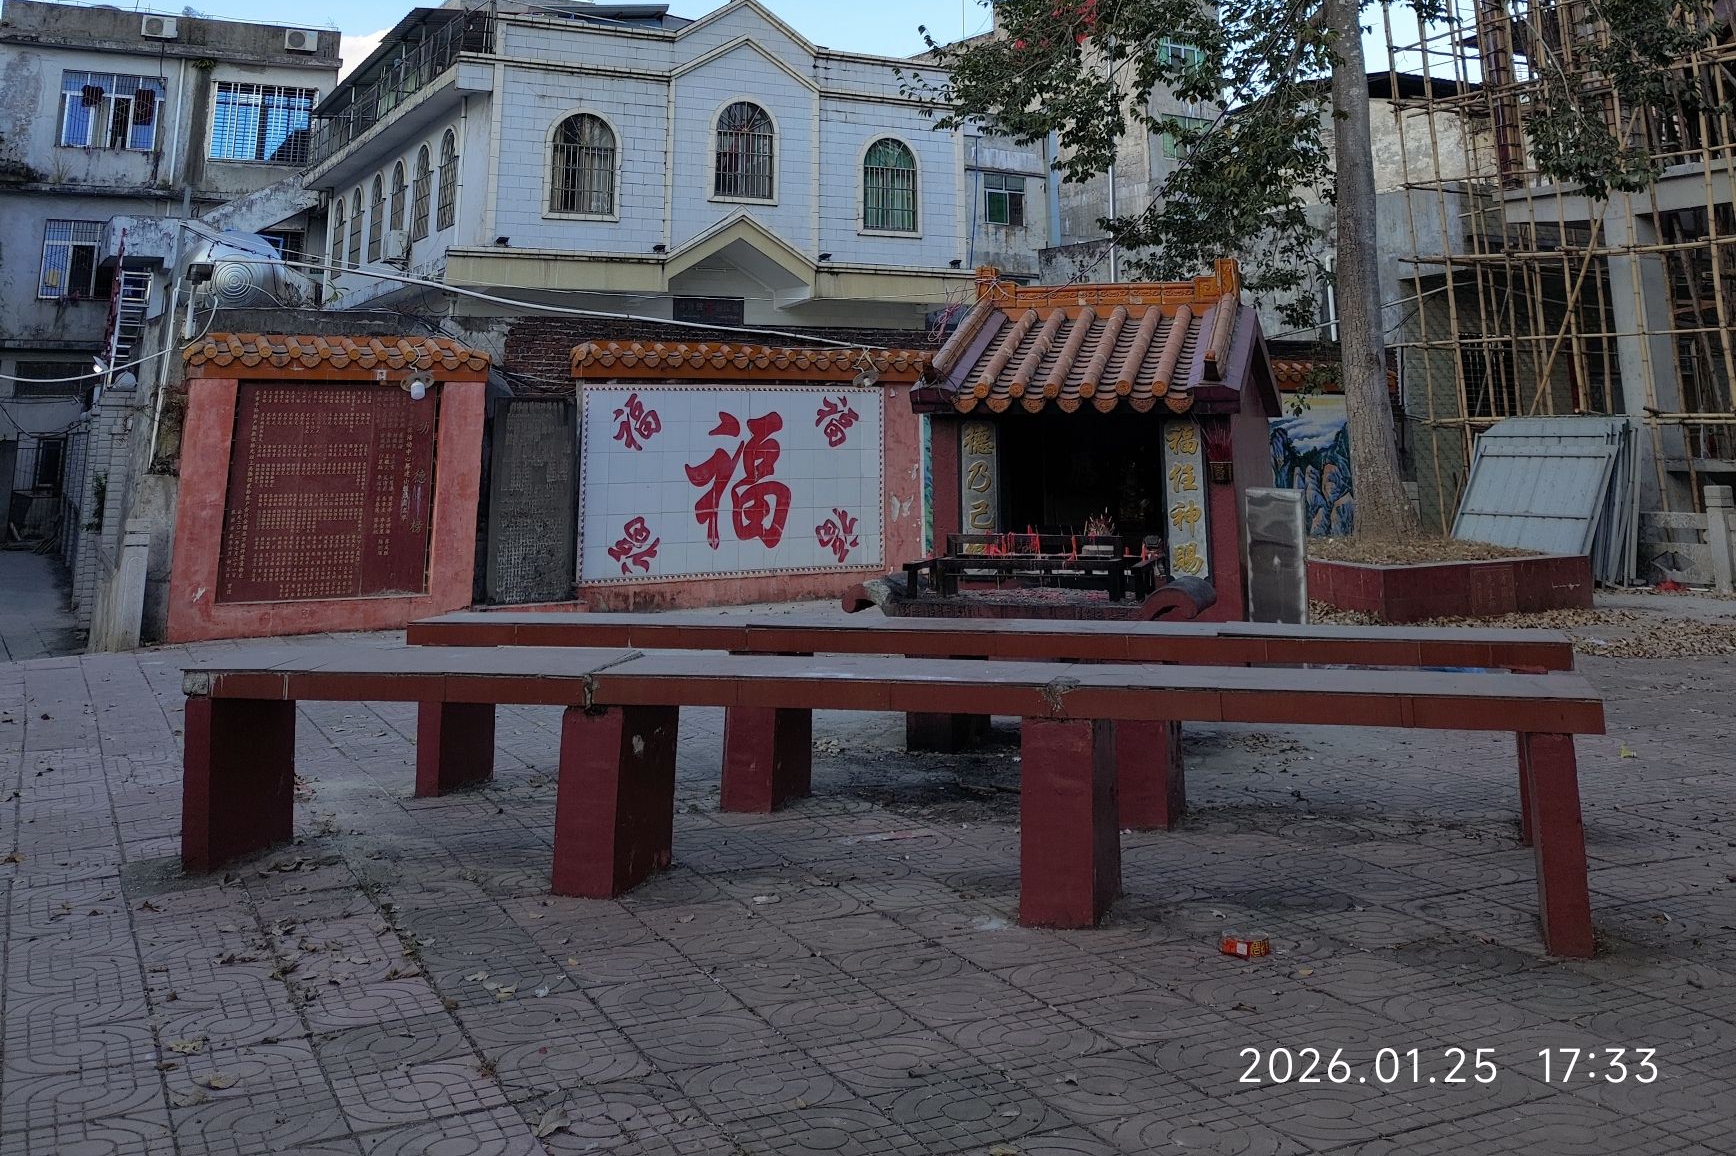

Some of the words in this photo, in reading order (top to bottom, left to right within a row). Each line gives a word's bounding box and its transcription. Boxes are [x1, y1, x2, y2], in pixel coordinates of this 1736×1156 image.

[613, 393, 662, 451] 福
[815, 395, 859, 448] 福
[684, 411, 792, 550] 福
